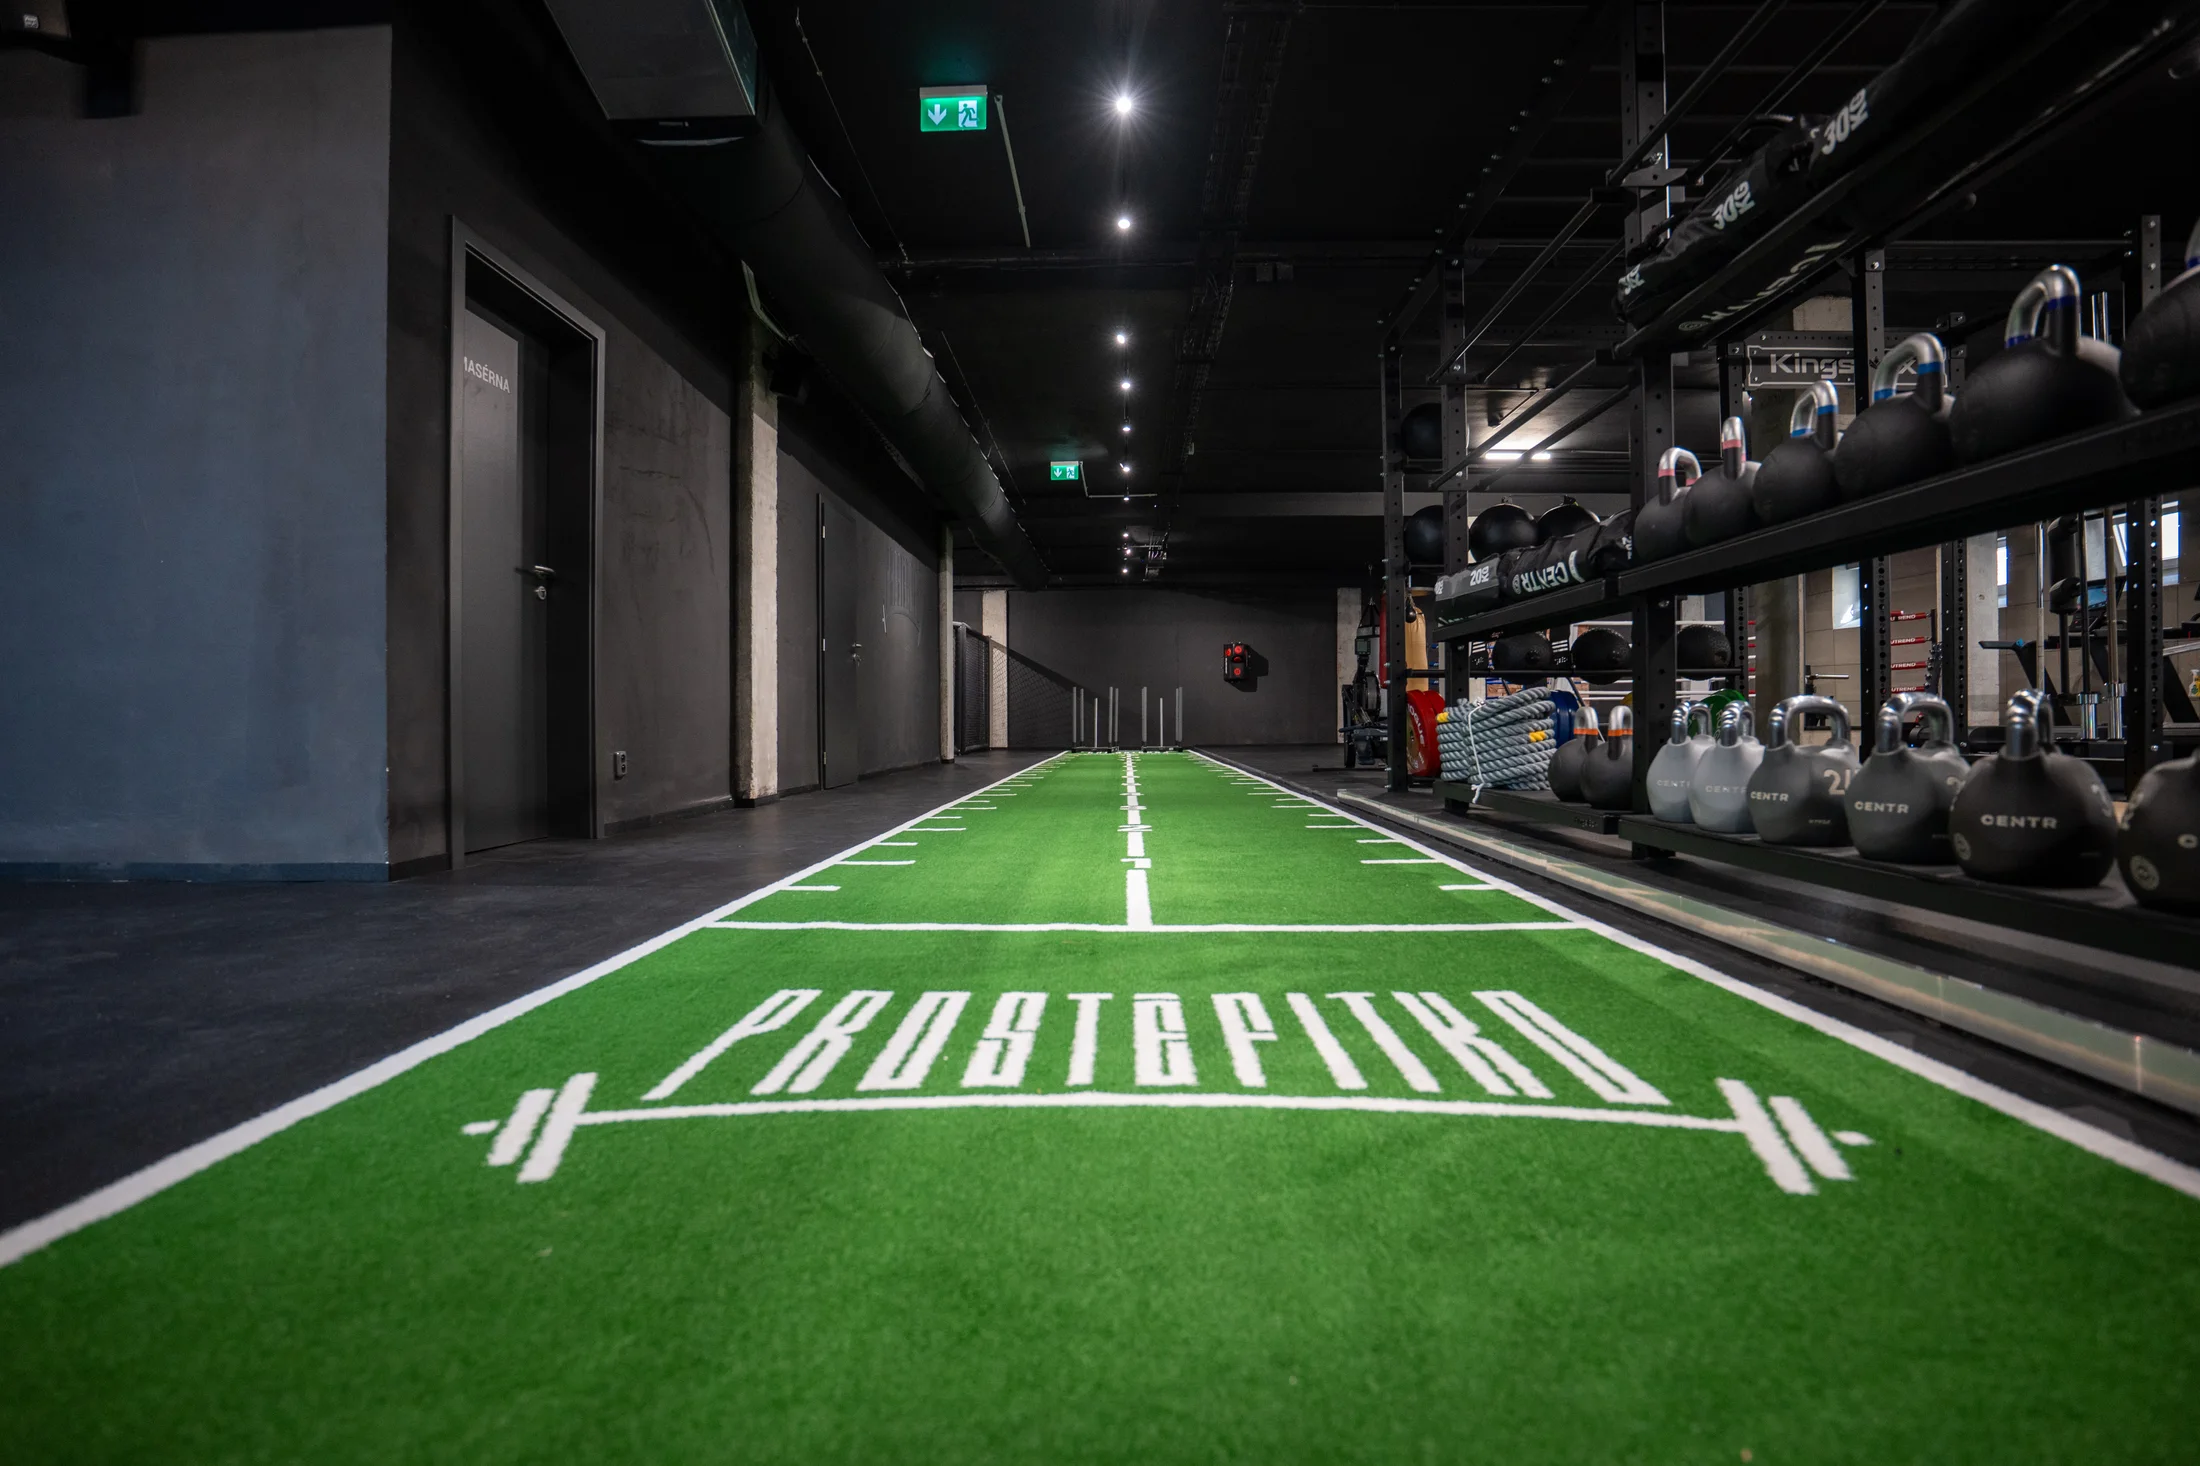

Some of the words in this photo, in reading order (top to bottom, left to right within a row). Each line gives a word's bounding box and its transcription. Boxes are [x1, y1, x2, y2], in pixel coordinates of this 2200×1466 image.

[1890, 637, 1916, 645] UTREND
[1750, 791, 1789, 802] CENTR
[1854, 801, 1909, 814] CENTR
[1980, 814, 2058, 829] CENTR
